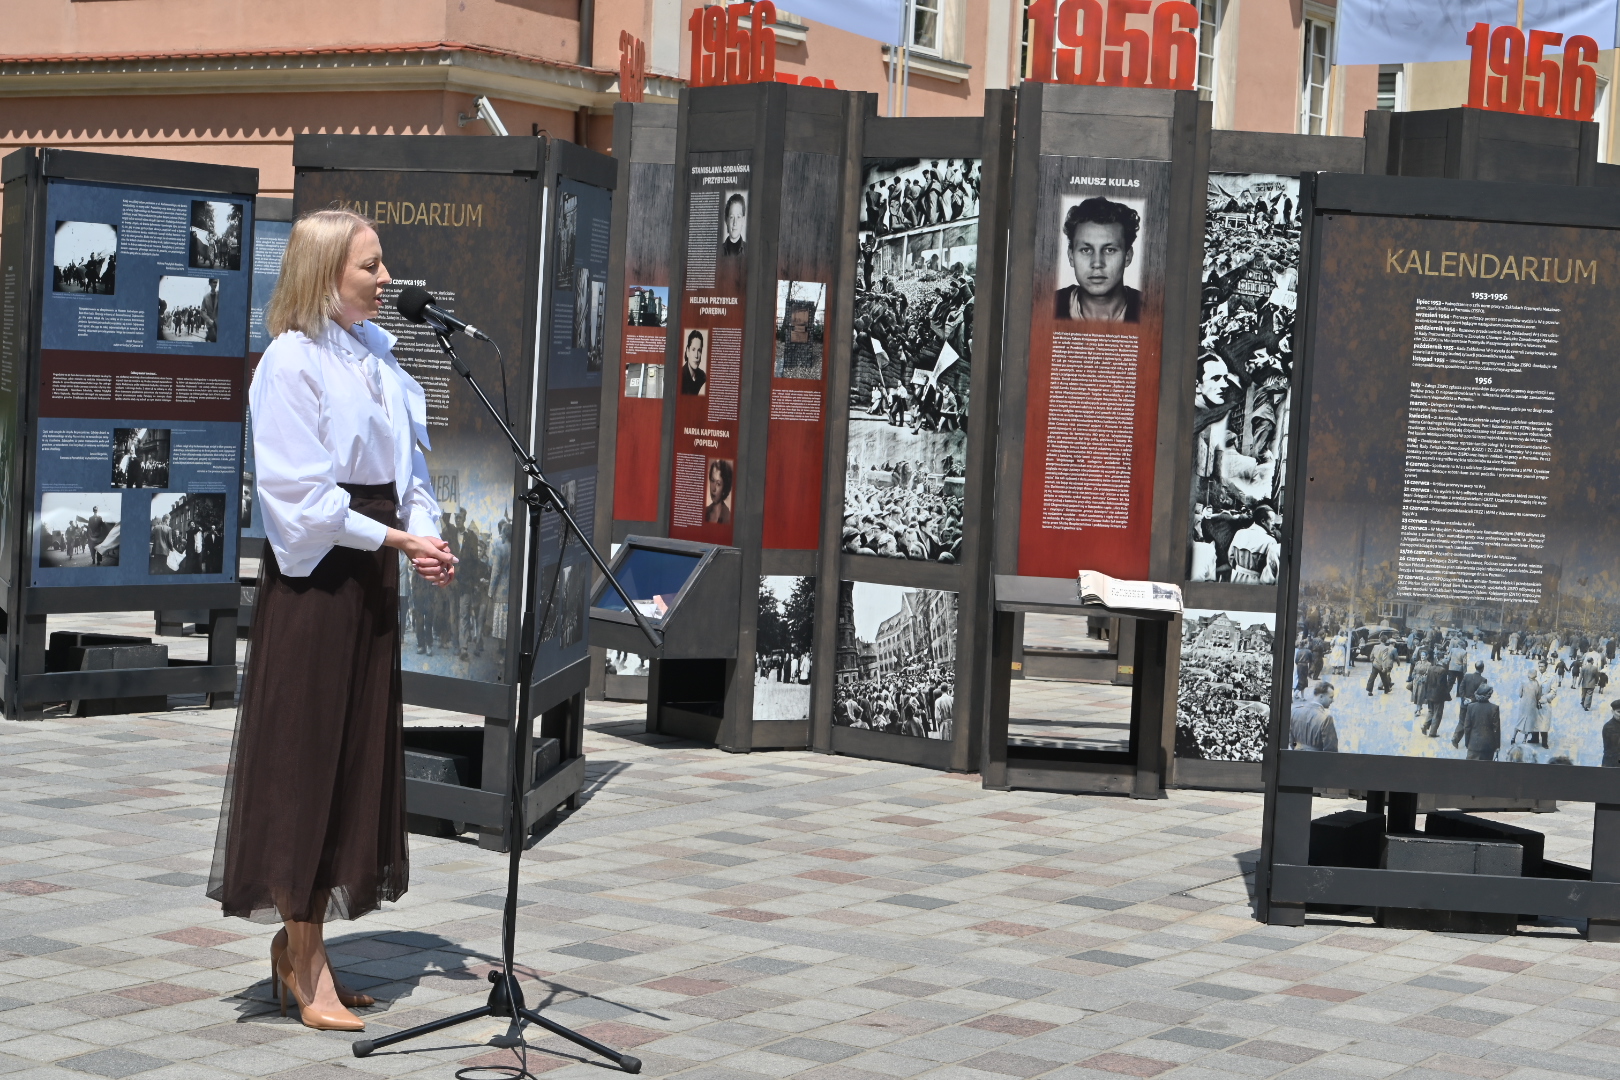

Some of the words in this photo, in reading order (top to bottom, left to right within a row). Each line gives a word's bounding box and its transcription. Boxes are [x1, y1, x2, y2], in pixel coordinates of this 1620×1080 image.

[688, 0, 776, 87] 1956
[1026, 0, 1199, 90] 1956
[1466, 22, 1599, 121] 1956
[1070, 176, 1106, 186] JANUSZ
[1108, 178, 1140, 187] KULAS
[1386, 248, 1598, 284] KALENDARIUM
[1471, 292, 1508, 301] 1953-1956
[1474, 377, 1492, 385] 1956
[684, 427, 700, 435] MARIA
